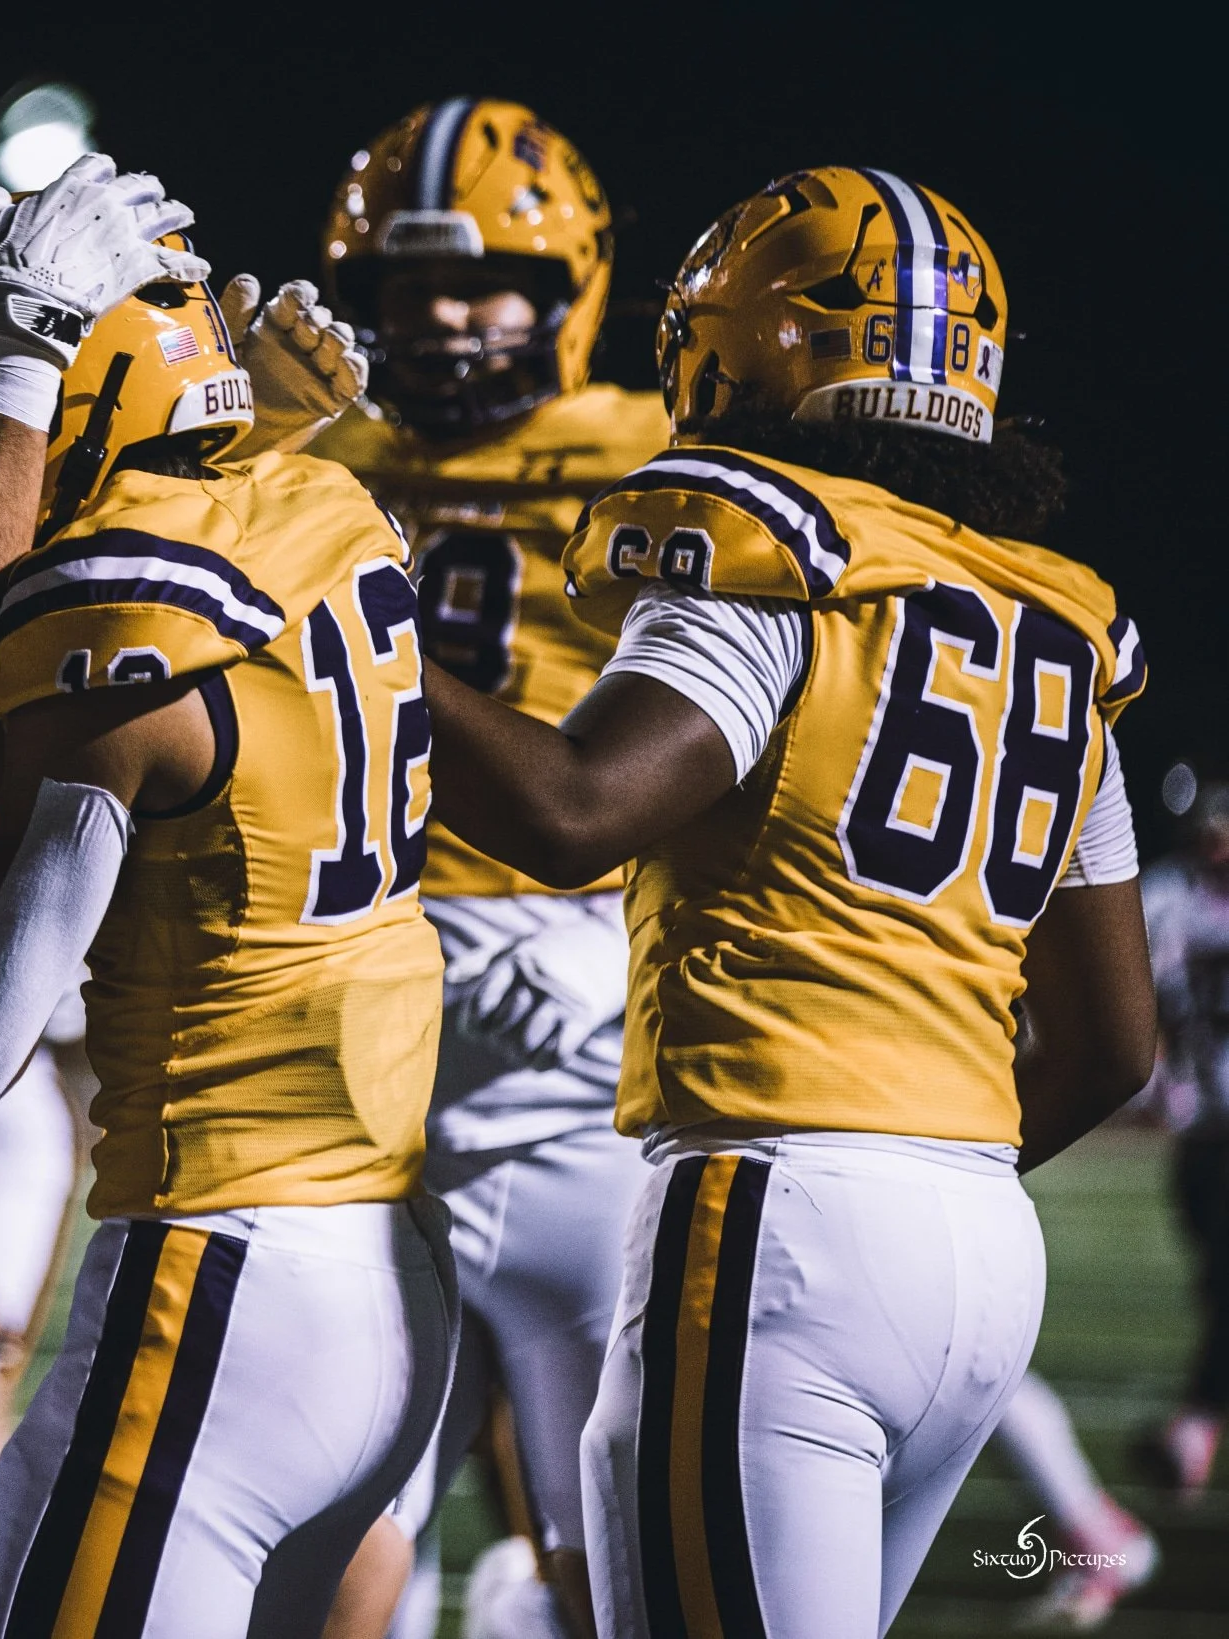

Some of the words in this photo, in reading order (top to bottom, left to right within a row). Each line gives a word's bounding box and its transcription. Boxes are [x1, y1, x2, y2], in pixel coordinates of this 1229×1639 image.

[833, 386, 984, 439] BULLDOGS
[300, 556, 433, 926] 12
[836, 576, 1100, 930] 68
